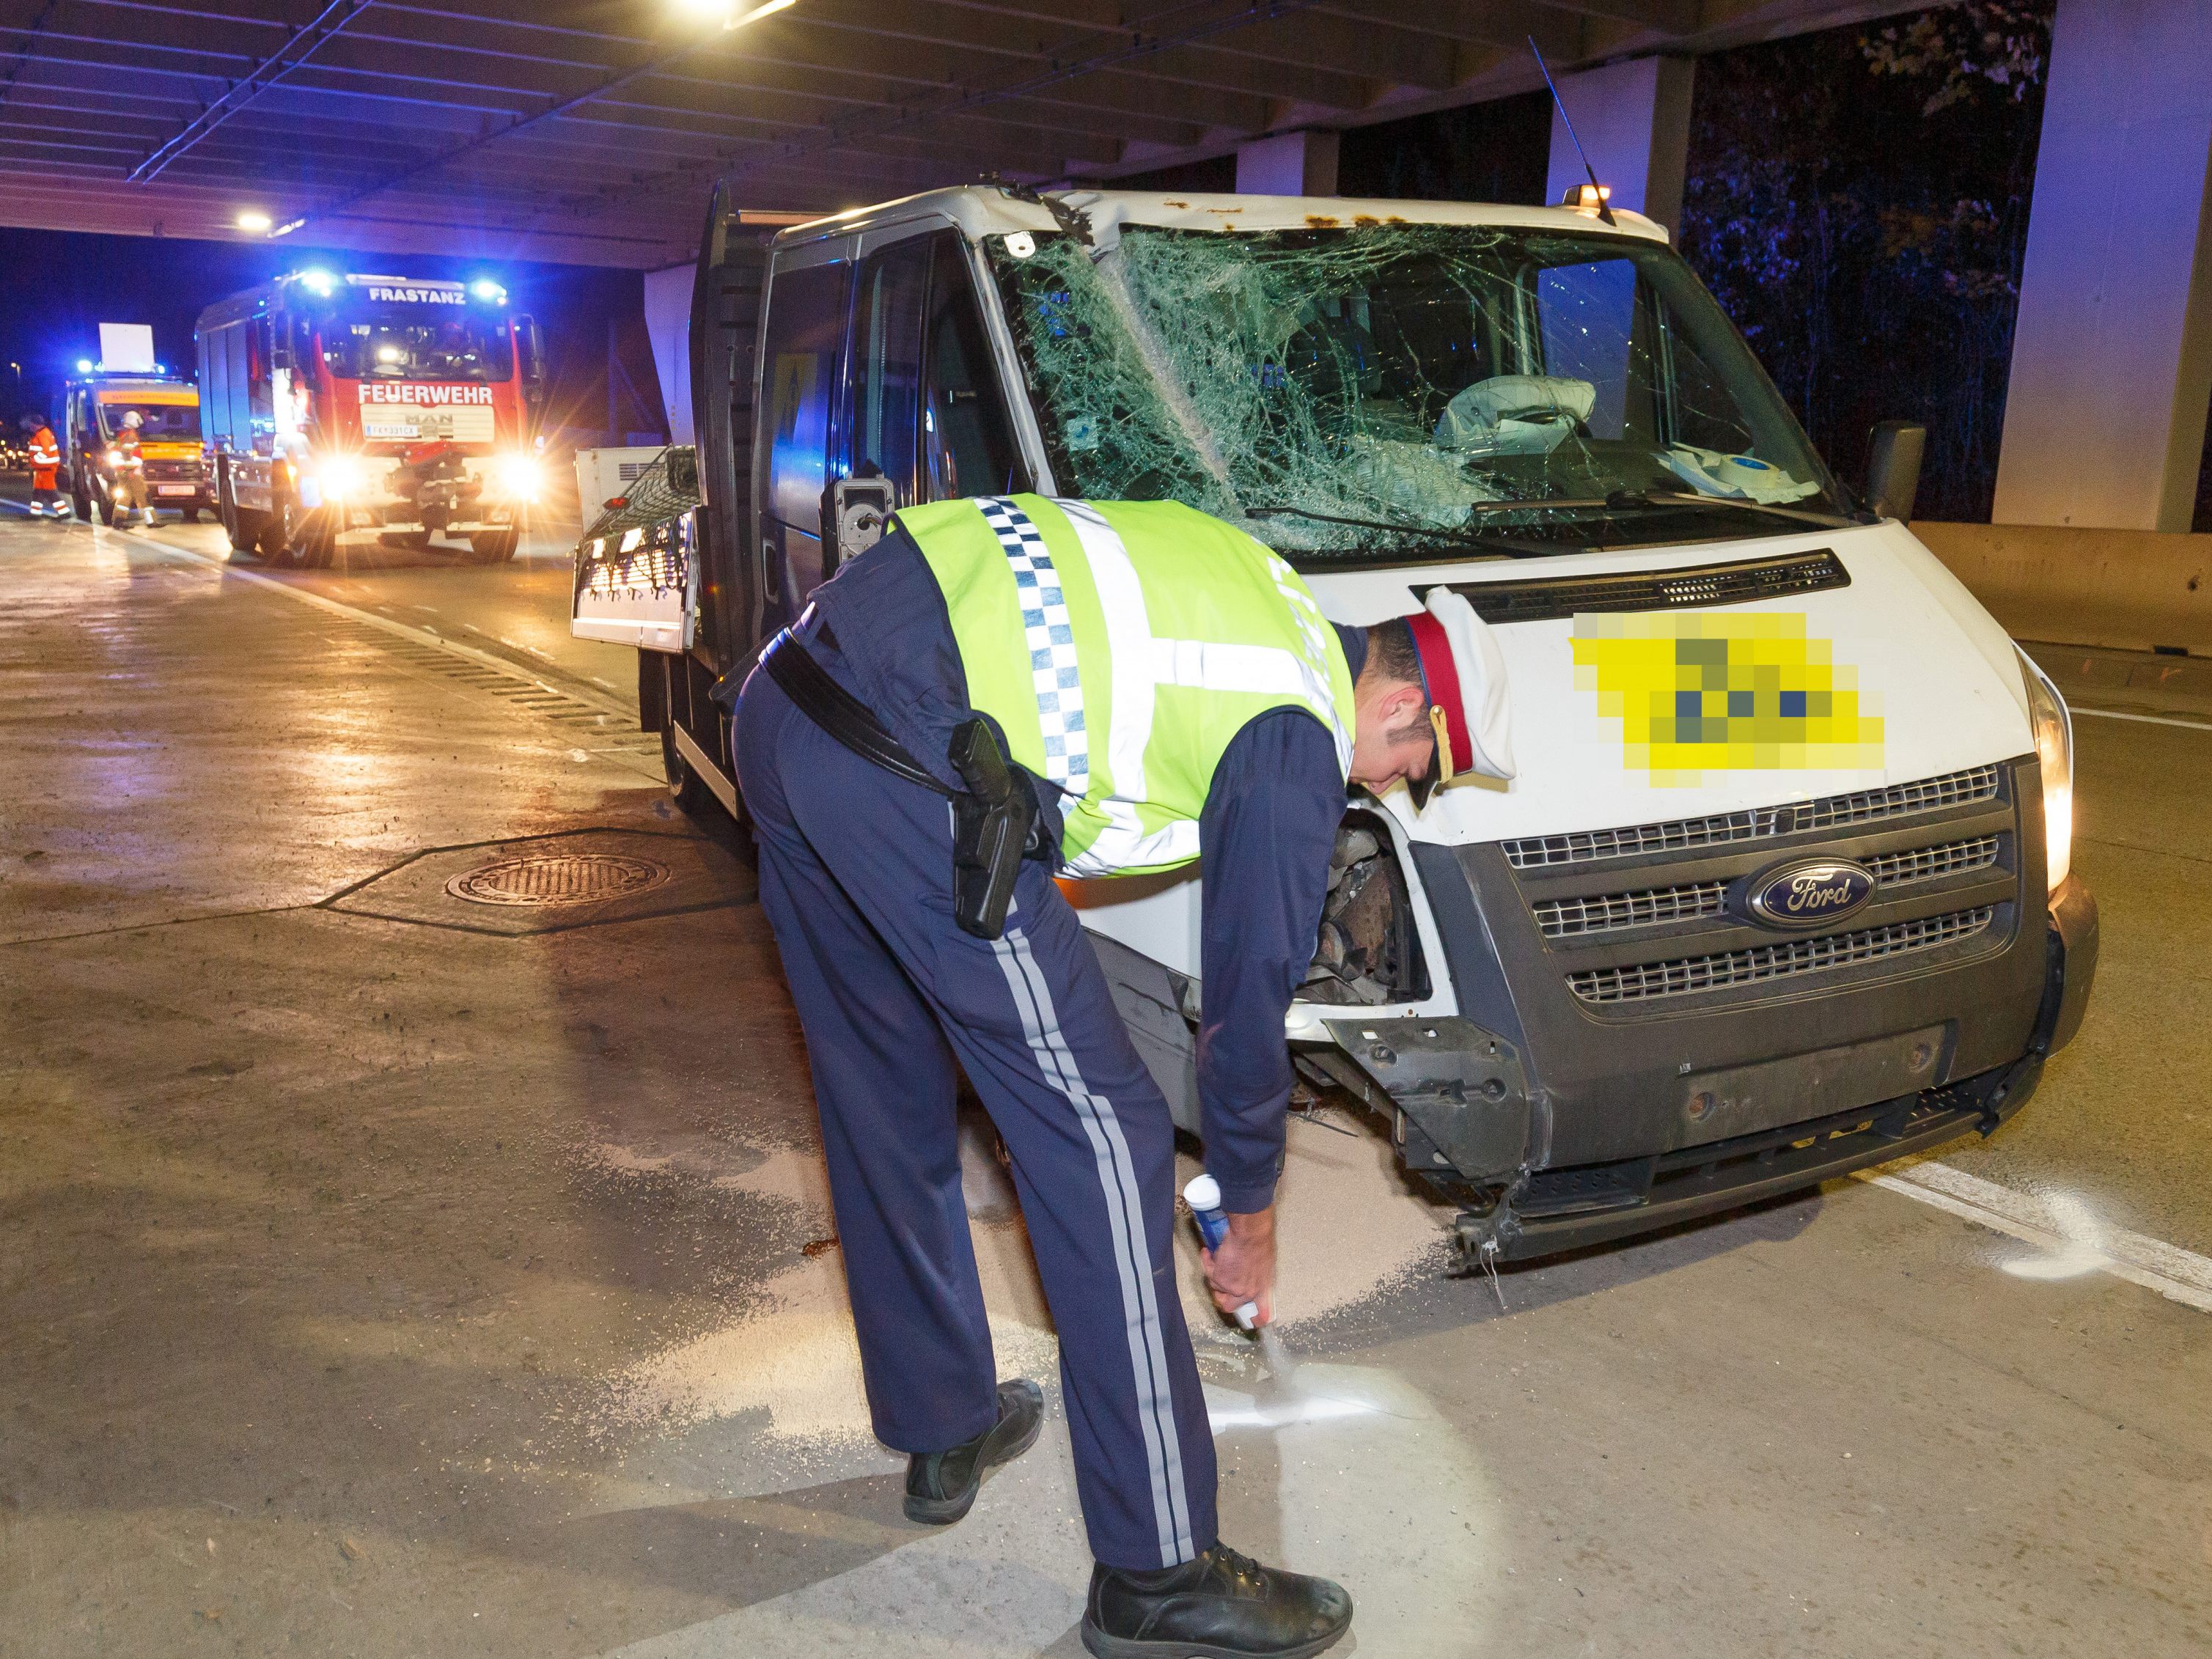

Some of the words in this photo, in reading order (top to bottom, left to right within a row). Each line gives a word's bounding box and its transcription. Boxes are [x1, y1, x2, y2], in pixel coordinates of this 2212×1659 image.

[369, 287, 466, 305] FRASTANZ
[358, 384, 493, 404] FEUERWEHR
[405, 414, 452, 425] MAN
[1787, 873, 1851, 911] Ford
